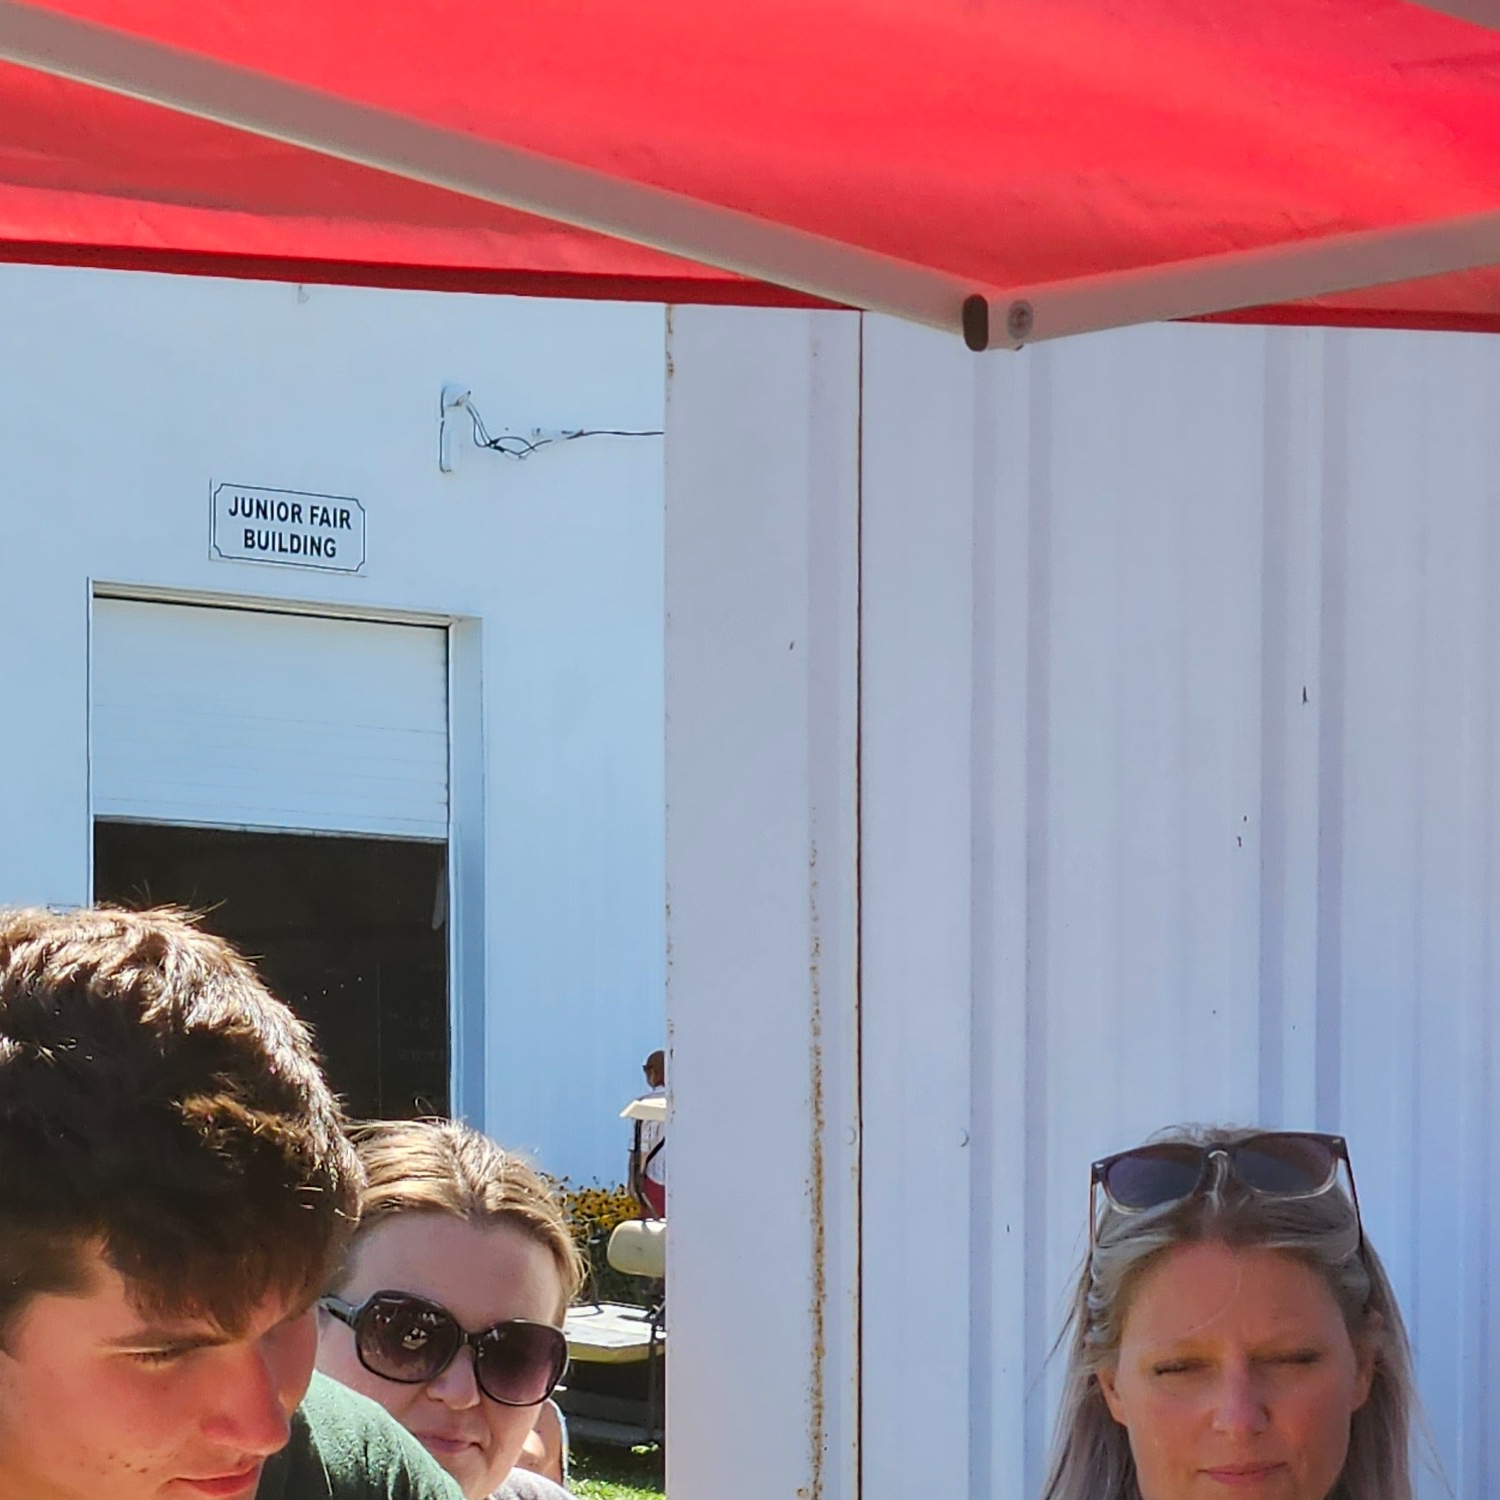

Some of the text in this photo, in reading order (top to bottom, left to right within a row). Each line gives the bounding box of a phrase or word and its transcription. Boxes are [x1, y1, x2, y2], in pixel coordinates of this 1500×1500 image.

[228, 496, 351, 530] JUNIOR FAIR
[244, 528, 337, 558] BUILDING
